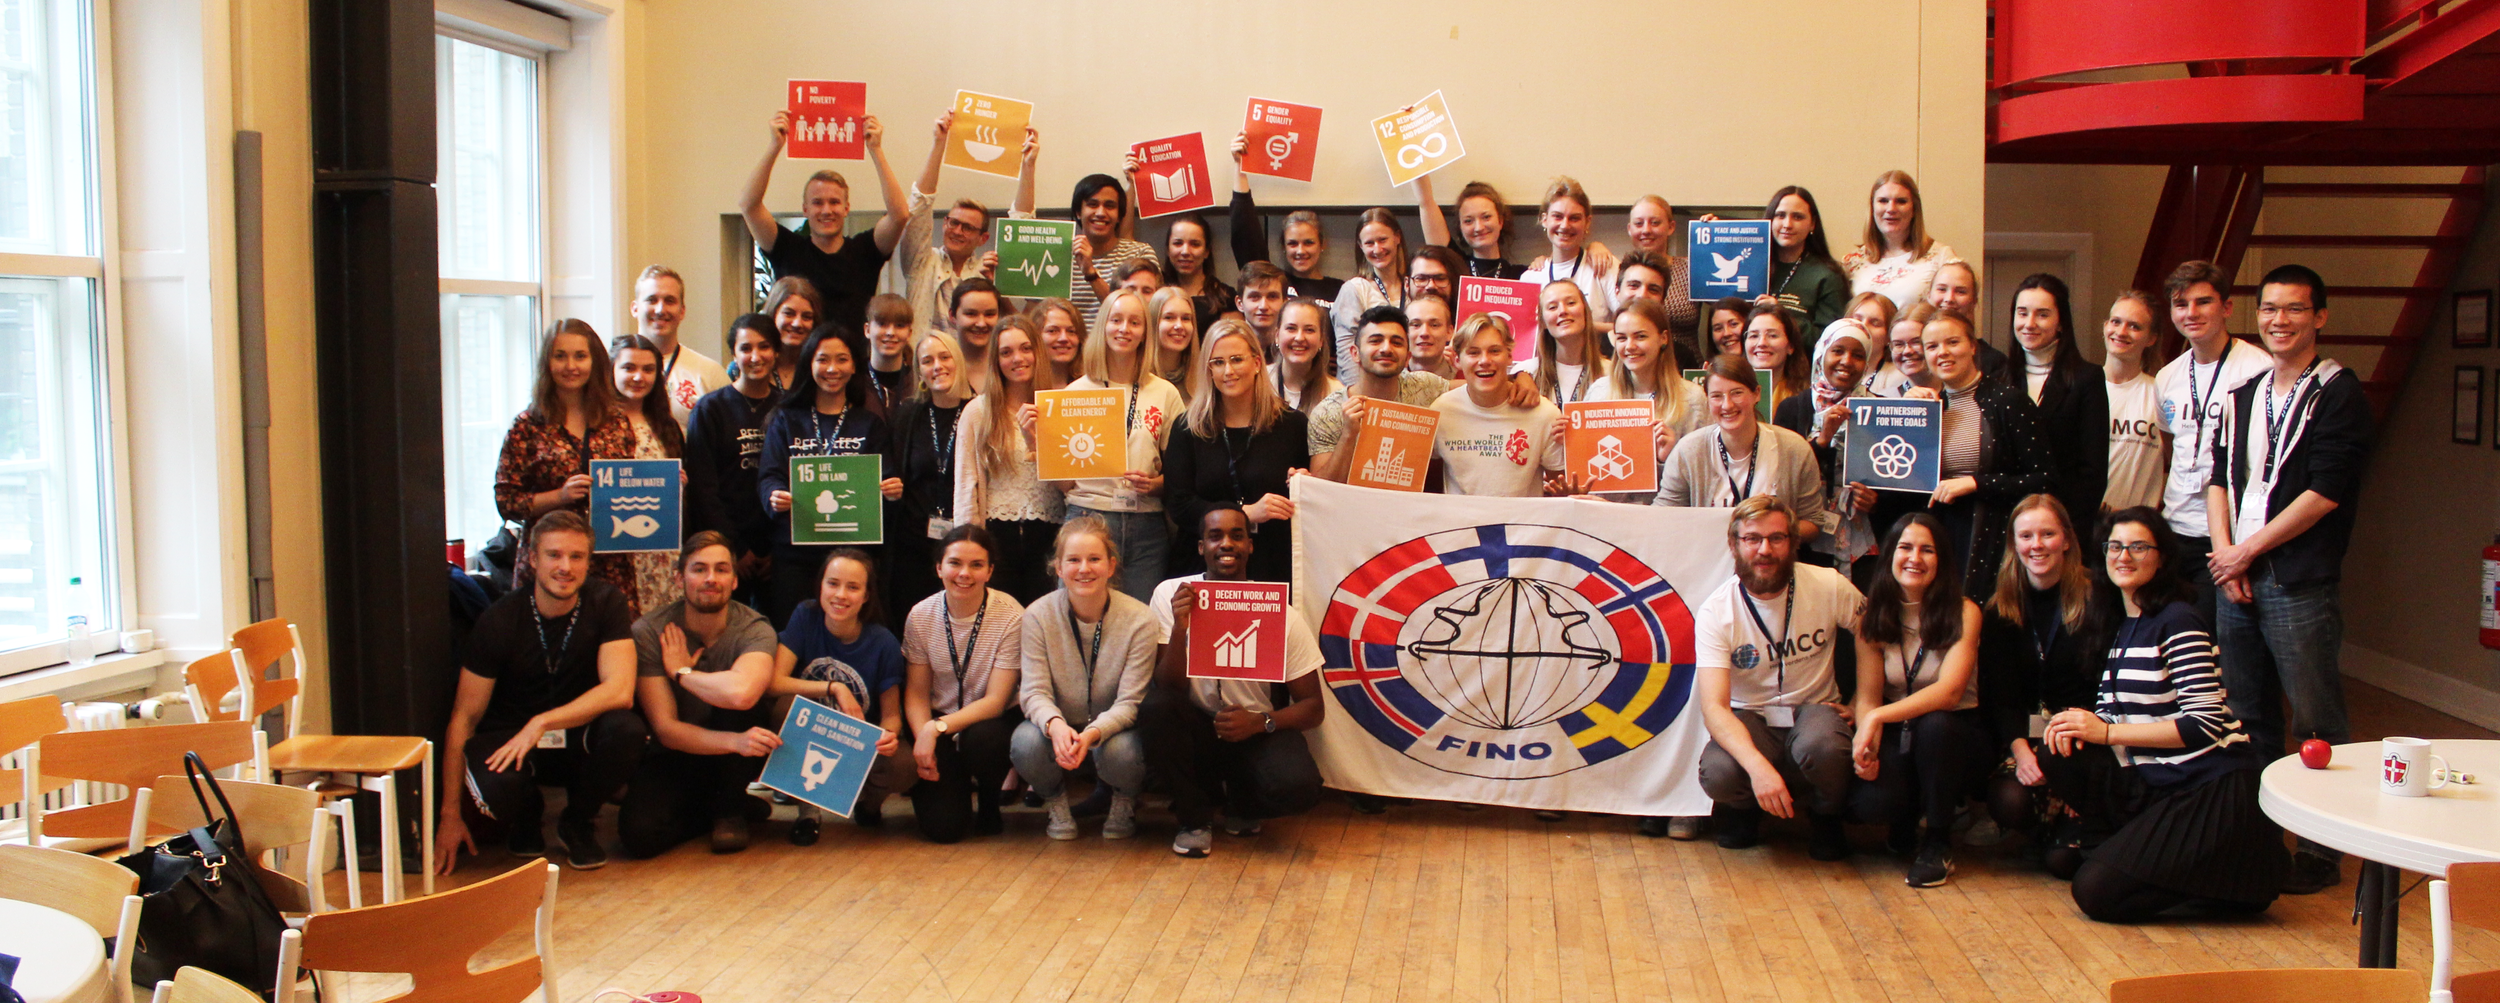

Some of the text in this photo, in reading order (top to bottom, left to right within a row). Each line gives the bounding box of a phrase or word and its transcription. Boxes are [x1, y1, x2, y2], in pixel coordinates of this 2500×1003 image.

[796, 86, 803, 103] 1
[809, 86, 819, 95] NO
[809, 96, 836, 104] POVERTY
[963, 97, 973, 113] 2
[976, 100, 992, 109] ZERO
[975, 109, 997, 119] HUNGER
[1252, 104, 1262, 120] 5
[1267, 106, 1289, 116] GENDER
[1396, 104, 1430, 125] RESPONSIBLE
[1265, 115, 1293, 125] EQUALITY
[1399, 111, 1436, 133] CONSUMPTION
[1402, 114, 1445, 141] AND PRODUCTION
[1380, 121, 1396, 138] 12
[1139, 147, 1148, 163] 4
[1150, 143, 1172, 154] QUALITY
[1151, 151, 1182, 162] EDUCATION
[1004, 225, 1013, 242] 3
[1018, 226, 1056, 235] GOOD HEALTH
[1695, 227, 1711, 244] 16
[1018, 235, 1063, 244] AND WELL-BEING
[1466, 284, 1482, 302] 10
[1485, 285, 1513, 295] REDUCED
[1484, 295, 1523, 306] INEQUALITIES
[1045, 399, 1054, 417] 7
[1061, 397, 1116, 406] AFFORDABLE AND
[1061, 408, 1107, 417] CLEAN ENERGY
[1367, 406, 1379, 426] 11
[1382, 408, 1436, 426] SUSTAINABLE CITIES
[1585, 407, 1650, 418] INDUSTRY, INNOVATION
[1855, 406, 1872, 425] 17
[1876, 406, 1928, 416] PARTNERSHIPS
[1380, 419, 1431, 435] AND COMMUNITIES
[1571, 410, 1581, 429] 9
[1586, 417, 1650, 429] AND INFRASTRUCTURE
[1876, 417, 1928, 427] FOR THE GOALS
[619, 467, 633, 476] LIFE
[798, 464, 814, 482] 15
[819, 463, 832, 472] LIFE
[596, 467, 614, 488] 14
[619, 478, 665, 487] BELOW WATER
[819, 473, 848, 481] ON LAND
[1198, 589, 1209, 610] 8
[1215, 590, 1280, 601] DECENT WORK AND
[1215, 601, 1281, 612] ECONOMIC GROWTH
[1767, 629, 1826, 661] IMCC
[795, 708, 811, 727] 6
[816, 714, 861, 737] CLEAN WATER
[811, 724, 865, 751] AND SANITATION
[1436, 734, 1552, 760] FINO
